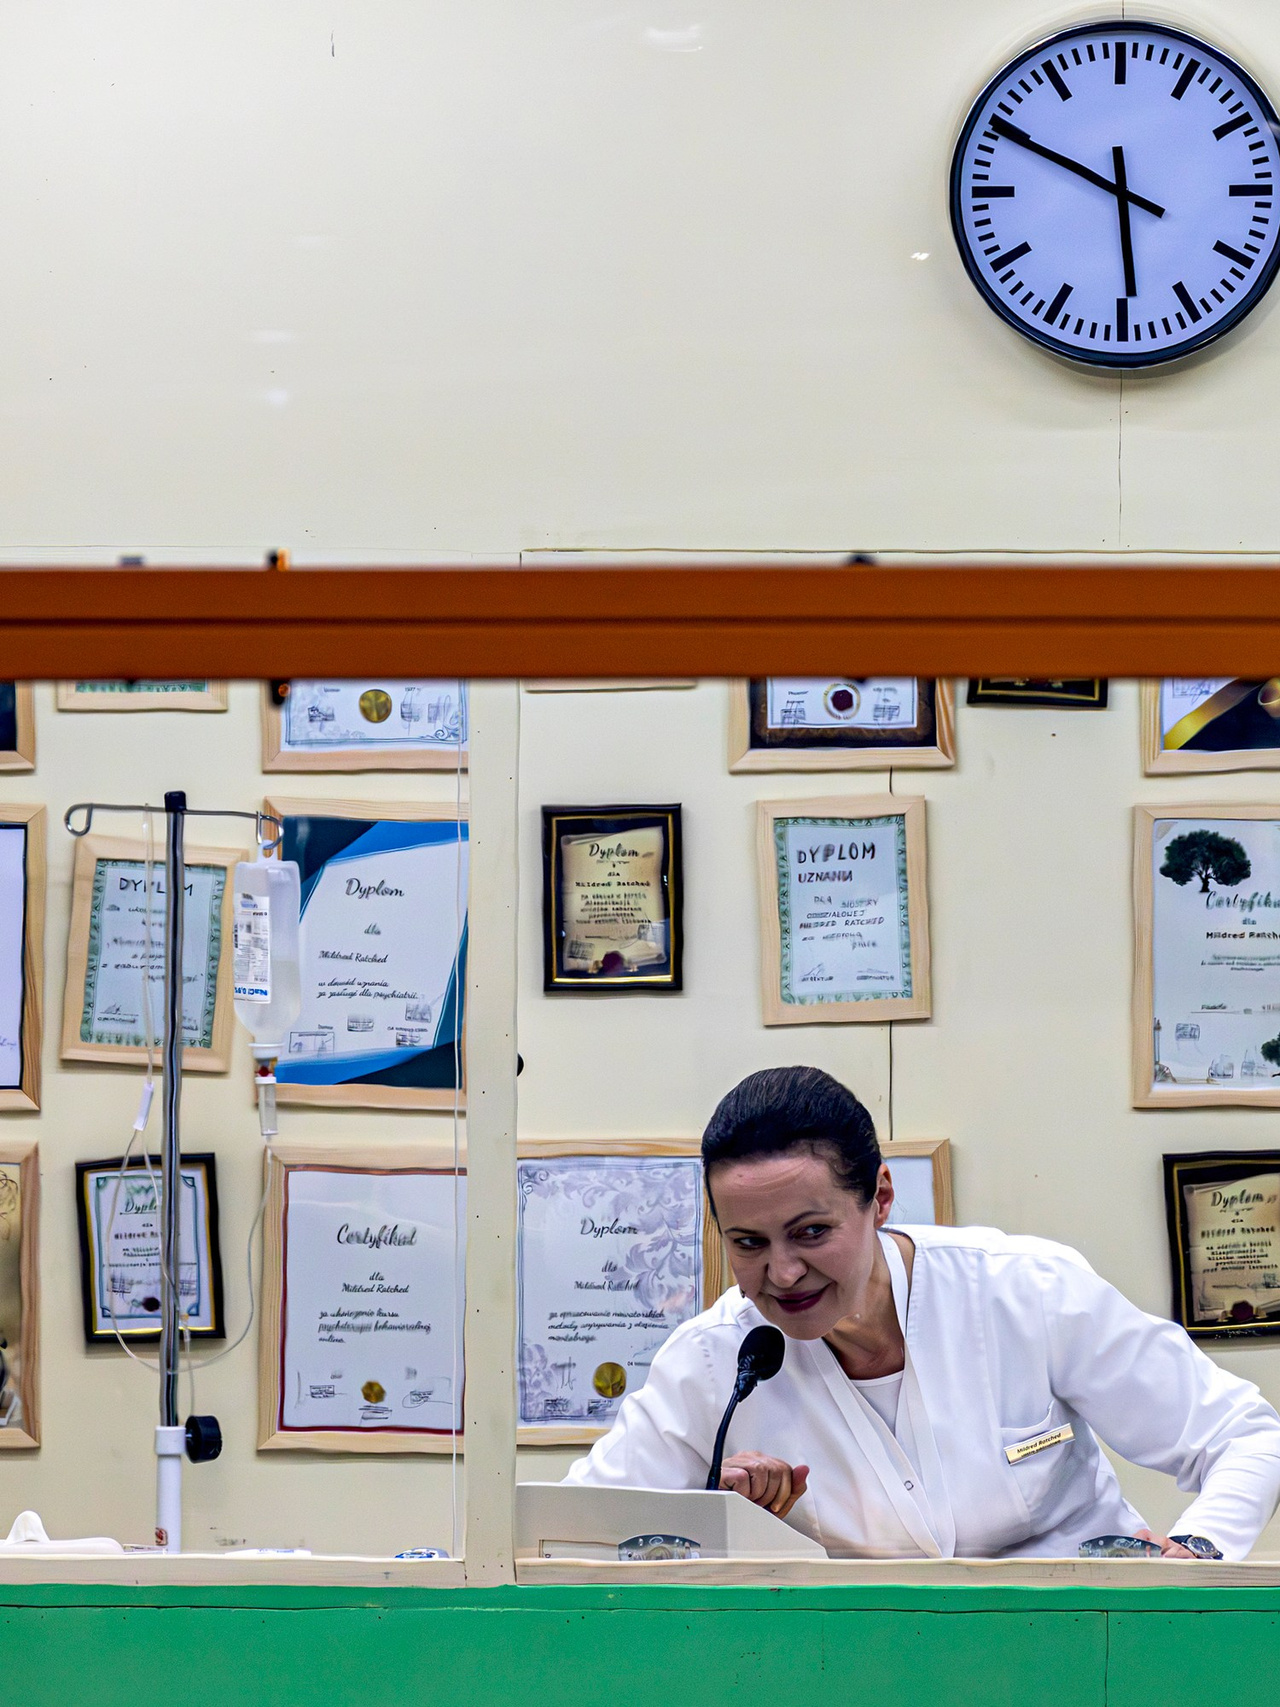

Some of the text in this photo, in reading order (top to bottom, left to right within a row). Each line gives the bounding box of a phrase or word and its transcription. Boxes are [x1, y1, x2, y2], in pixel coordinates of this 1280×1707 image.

[588, 843, 640, 858] Dyplom
[797, 842, 876, 864] DYPLOM
[119, 877, 194, 896] DYPLM
[345, 877, 405, 899] Dyplom
[364, 923, 382, 935] dla
[1206, 931, 1245, 939] Mildred
[318, 950, 388, 963] Mildred Ratched
[1211, 1189, 1264, 1208] Dyplom
[580, 1217, 638, 1238] Dyplom
[337, 1223, 417, 1249] Certyfikat
[601, 1260, 617, 1273] dla
[369, 1271, 385, 1281] dla
[342, 1283, 409, 1293] Mildred Ratched
[574, 1280, 605, 1291] Mildred
[1016, 1442, 1038, 1454] Mildred
[1038, 1432, 1062, 1446] Ratched
